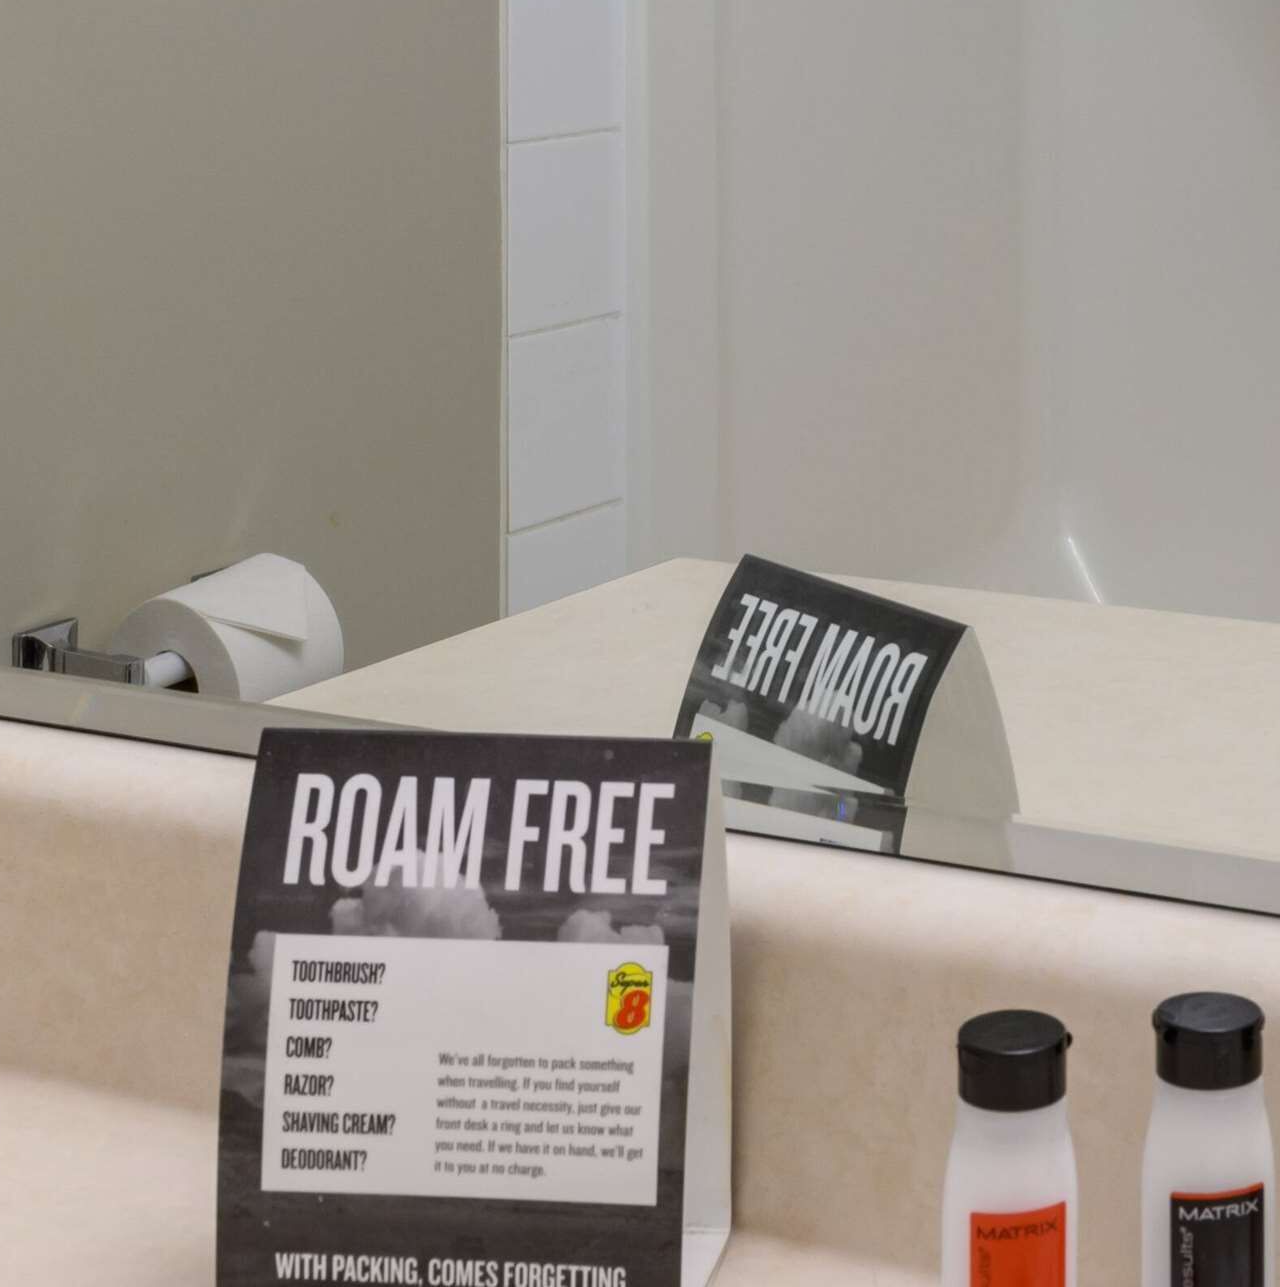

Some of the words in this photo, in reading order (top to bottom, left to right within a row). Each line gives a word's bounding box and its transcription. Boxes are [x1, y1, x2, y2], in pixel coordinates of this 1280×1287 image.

[283, 772, 491, 890] ROAM
[504, 778, 676, 895] FREE
[292, 960, 386, 985] TOOTHBRUSH?
[289, 998, 379, 1023] TOOTHPASTE?
[614, 989, 650, 1031] 8
[286, 1035, 333, 1059] COMB?
[438, 1051, 470, 1067] We've
[472, 1053, 485, 1067] all
[487, 1053, 536, 1070] forgotten
[538, 1057, 549, 1069] to
[551, 1057, 576, 1072] pack
[579, 1058, 634, 1075] something
[284, 1073, 335, 1096] RAZOR?
[437, 1074, 466, 1088] when
[468, 1075, 521, 1092] travelling.
[523, 1076, 531, 1089] If
[533, 1079, 553, 1093] you
[555, 1078, 575, 1091] find
[577, 1079, 621, 1095] yourself
[436, 1096, 476, 1110] without
[481, 1099, 488, 1110] a
[490, 1098, 521, 1111] travel
[523, 1100, 575, 1115] necessity,
[576, 1100, 597, 1116] just
[600, 1103, 621, 1117] give
[624, 1105, 642, 1116] our
[282, 1111, 340, 1134] SHAVING
[342, 1113, 396, 1136] CREAM?
[435, 1116, 461, 1130] front
[464, 1117, 489, 1131] desk
[491, 1120, 498, 1132] a
[500, 1119, 522, 1136] ring
[524, 1120, 544, 1133] and
[546, 1120, 560, 1134] let
[562, 1124, 575, 1135] us
[577, 1121, 605, 1136] know
[607, 1123, 634, 1137] what
[281, 1148, 368, 1172] DEODORANT?
[435, 1139, 454, 1153] you
[456, 1139, 485, 1152] need.
[487, 1139, 495, 1152] If
[498, 1142, 513, 1154] we
[515, 1140, 540, 1155] have
[543, 1143, 550, 1155] it
[552, 1144, 566, 1156] on
[568, 1142, 598, 1159] hand,
[601, 1144, 625, 1159] we'll
[627, 1146, 644, 1162] get
[434, 1159, 442, 1172] it
[444, 1159, 455, 1173] to
[457, 1162, 476, 1176] you
[478, 1161, 489, 1174] at
[491, 1162, 505, 1175] no
[507, 1161, 548, 1180] charge.
[1178, 1198, 1259, 1221] MATRIX
[976, 1218, 1058, 1240] MATRIX
[275, 1252, 328, 1281] WITH
[331, 1254, 423, 1287] PACKING,
[428, 1258, 499, 1287] COMES
[503, 1261, 627, 1287] FORGETTING
